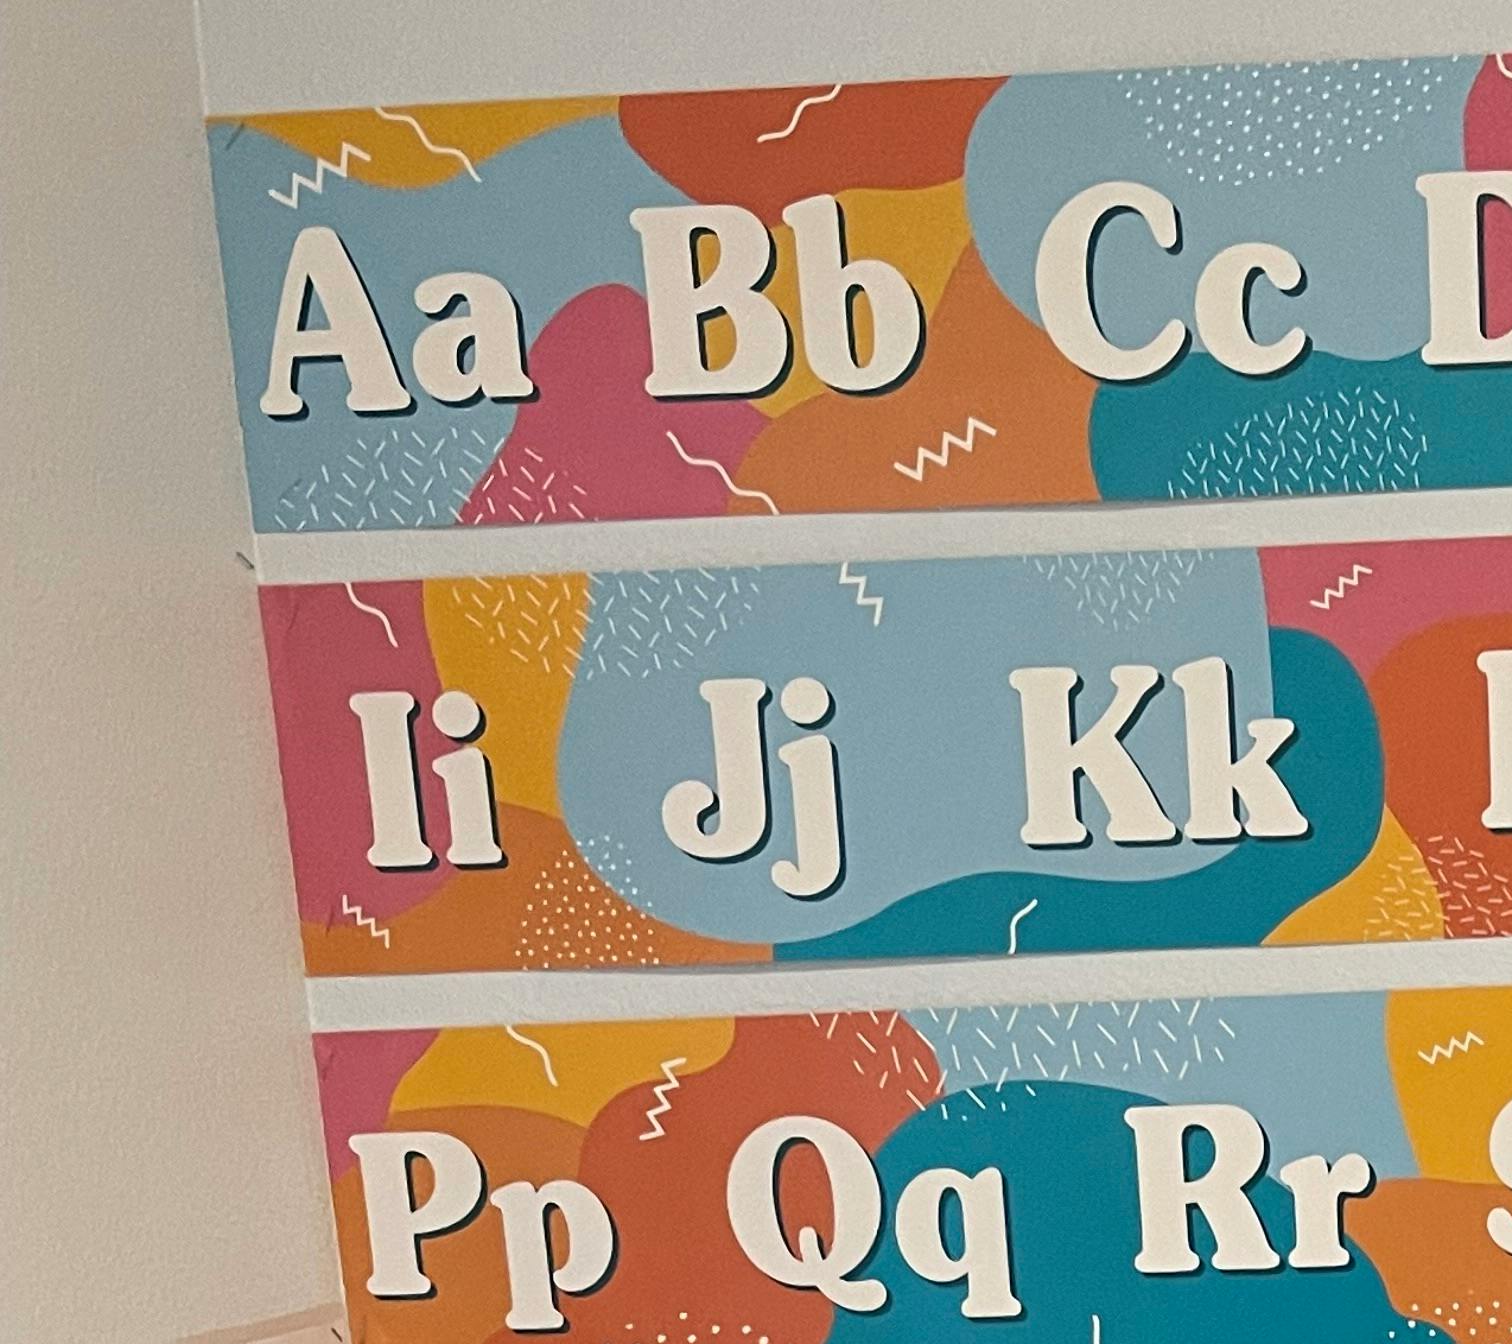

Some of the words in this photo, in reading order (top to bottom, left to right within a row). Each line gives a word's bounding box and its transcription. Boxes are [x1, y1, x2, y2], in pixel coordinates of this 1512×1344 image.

[260, 227, 537, 418] Aa
[630, 194, 926, 399] Bb
[1035, 181, 1312, 383] Cc
[349, 690, 506, 871] Ii
[662, 678, 844, 898] Jj
[1010, 657, 1312, 847] Kk
[349, 1133, 618, 1332] Pp
[727, 1116, 1024, 1320] Qq
[1125, 1105, 1374, 1273] Rr
